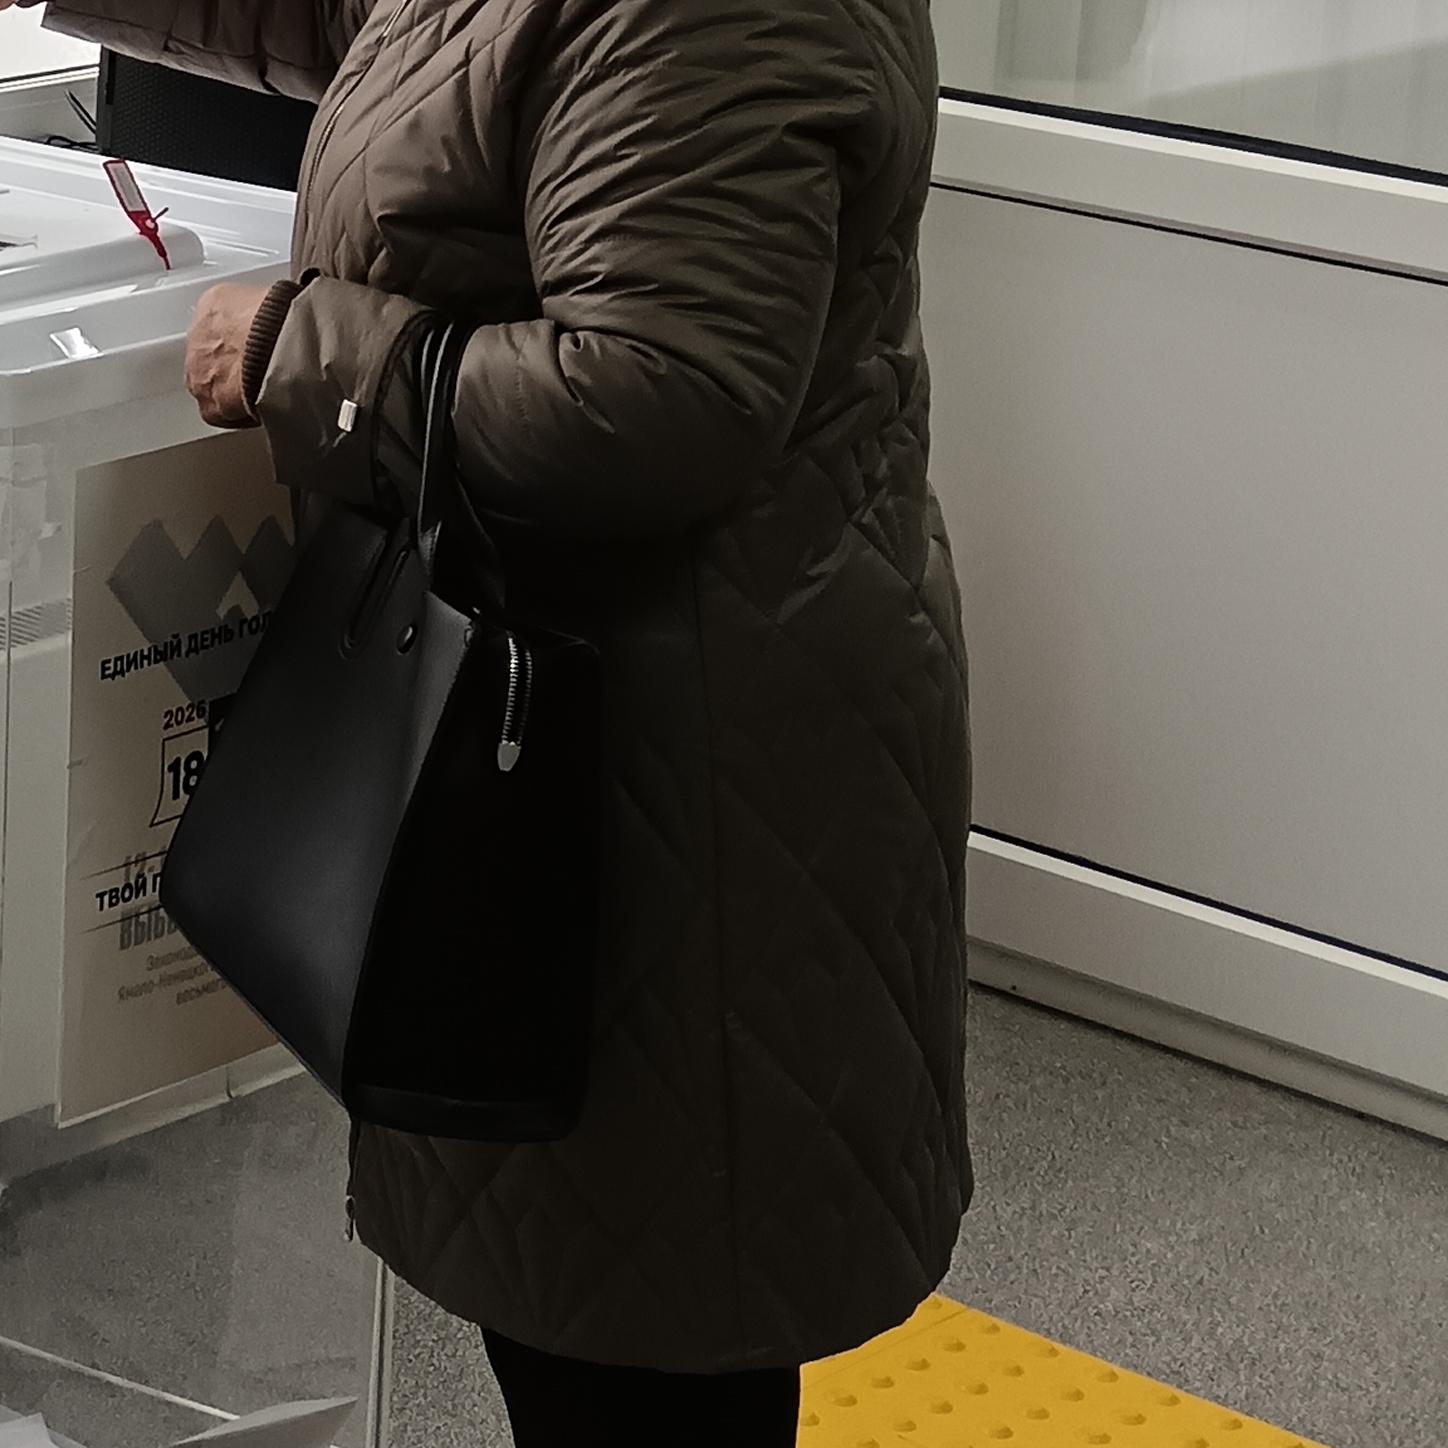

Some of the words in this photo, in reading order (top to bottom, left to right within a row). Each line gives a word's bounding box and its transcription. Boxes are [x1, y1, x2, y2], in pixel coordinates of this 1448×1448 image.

[100, 632, 183, 681] ЕДИНЫЙ
[185, 623, 236, 659] ДЕНЬ
[162, 699, 207, 730] 2026
[167, 750, 204, 801] 18
[95, 871, 147, 912] ТВОЙ
